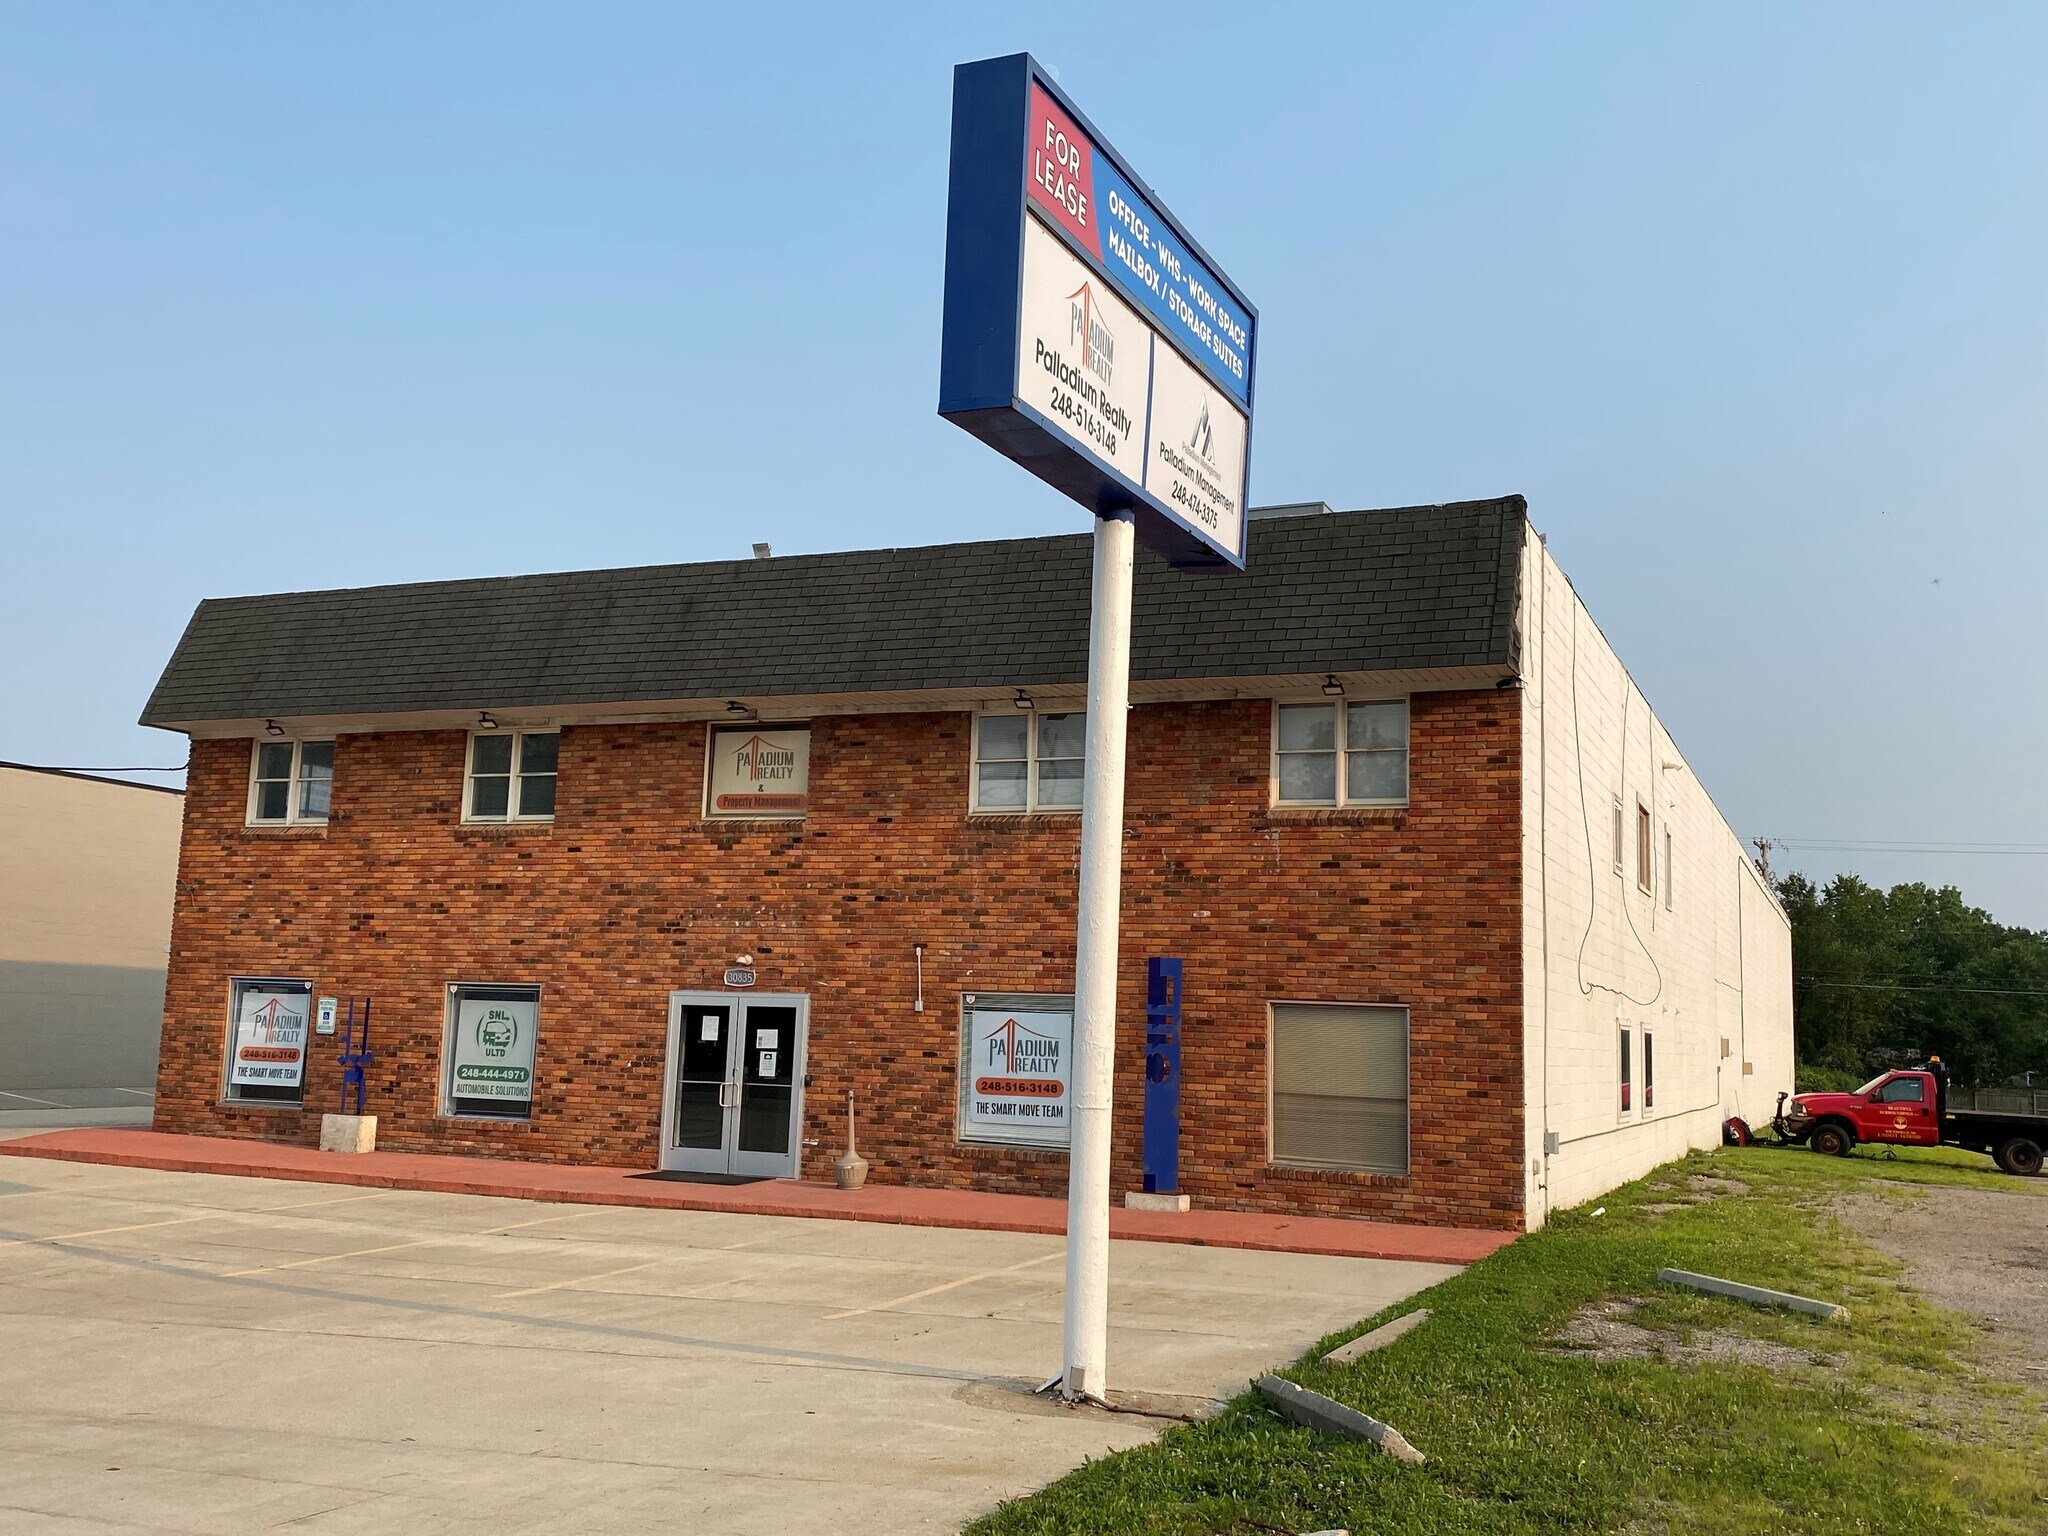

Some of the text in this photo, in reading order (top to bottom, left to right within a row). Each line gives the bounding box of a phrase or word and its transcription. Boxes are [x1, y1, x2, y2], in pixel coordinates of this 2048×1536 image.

[1045, 118, 1080, 182] FOR
[1035, 147, 1087, 227] LEASE
[1109, 190, 1150, 249] OFFICE
[1158, 240, 1181, 283] WHS
[1188, 274, 1217, 322] WORK
[1218, 307, 1245, 352] SPACE
[1109, 226, 1160, 296] MAILBOX
[1169, 287, 1212, 349] STORAGE
[1213, 333, 1243, 380] SUITES
[1088, 345, 1113, 388] REALTY
[1036, 337, 1132, 441] Palladium Realty
[1050, 385, 1117, 456] 248-516-3148
[1160, 441, 1235, 516] Palladium Management
[1171, 479, 1218, 530] 248-474-3375
[757, 766, 794, 781] REALTY
[758, 784, 764, 792] &
[723, 796, 752, 808] Property
[727, 972, 753, 983] 30835
[271, 1030, 300, 1043] REALTY
[243, 1049, 297, 1060] 248-516-3148
[485, 1048, 506, 1057] ULTD
[237, 1066, 298, 1079] THE SMART MOVE TEAM
[461, 1068, 525, 1080] 248-444-4971
[1015, 1057, 1059, 1075] REALTY
[456, 1083, 529, 1097] AUTOMOBILE SOLUTIONS
[976, 1102, 1063, 1118] THE SMART MOVE TEAM
